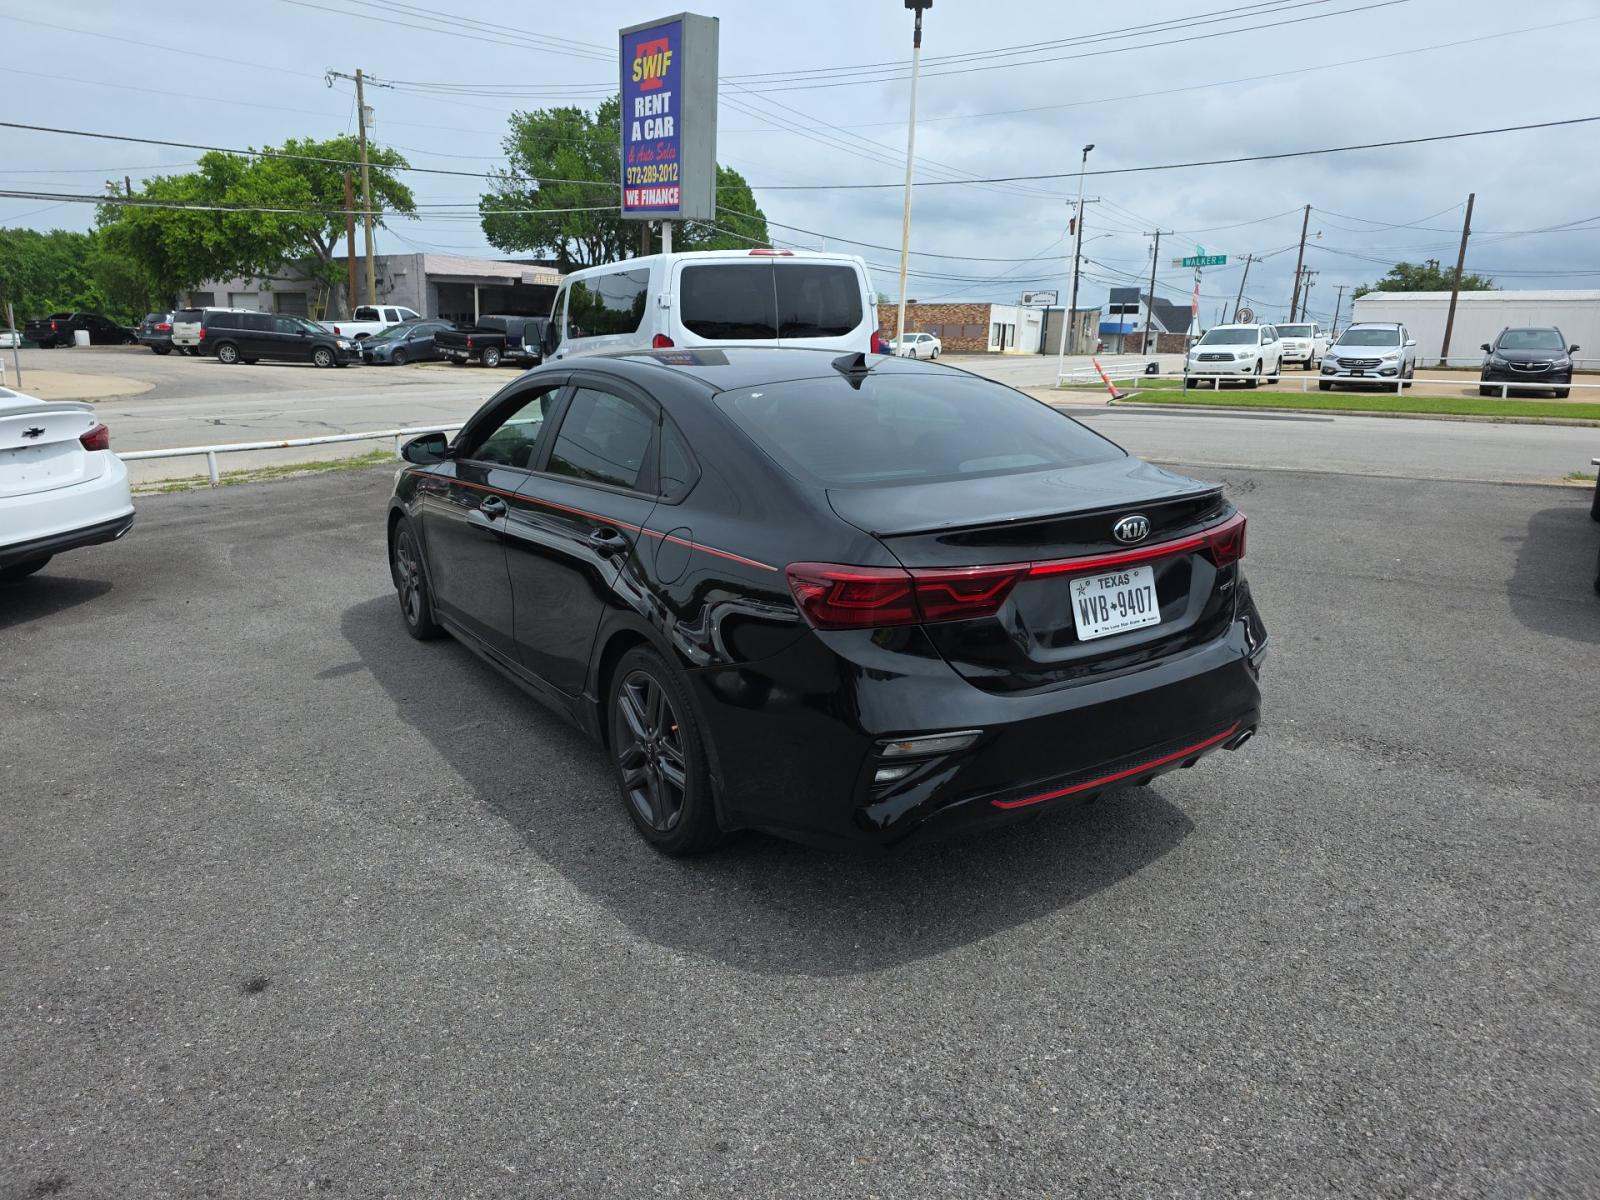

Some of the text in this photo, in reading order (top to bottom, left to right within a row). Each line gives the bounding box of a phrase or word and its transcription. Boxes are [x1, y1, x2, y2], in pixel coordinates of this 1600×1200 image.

[635, 91, 672, 117] RENT
[631, 116, 674, 142] A CAR
[627, 163, 678, 184] 972-289-2012
[626, 187, 679, 206] WE FINANCE
[1186, 256, 1217, 266] WALKER
[1122, 521, 1147, 539] KIA
[1098, 573, 1130, 590] TEXAS
[1117, 586, 1152, 618] 9407
